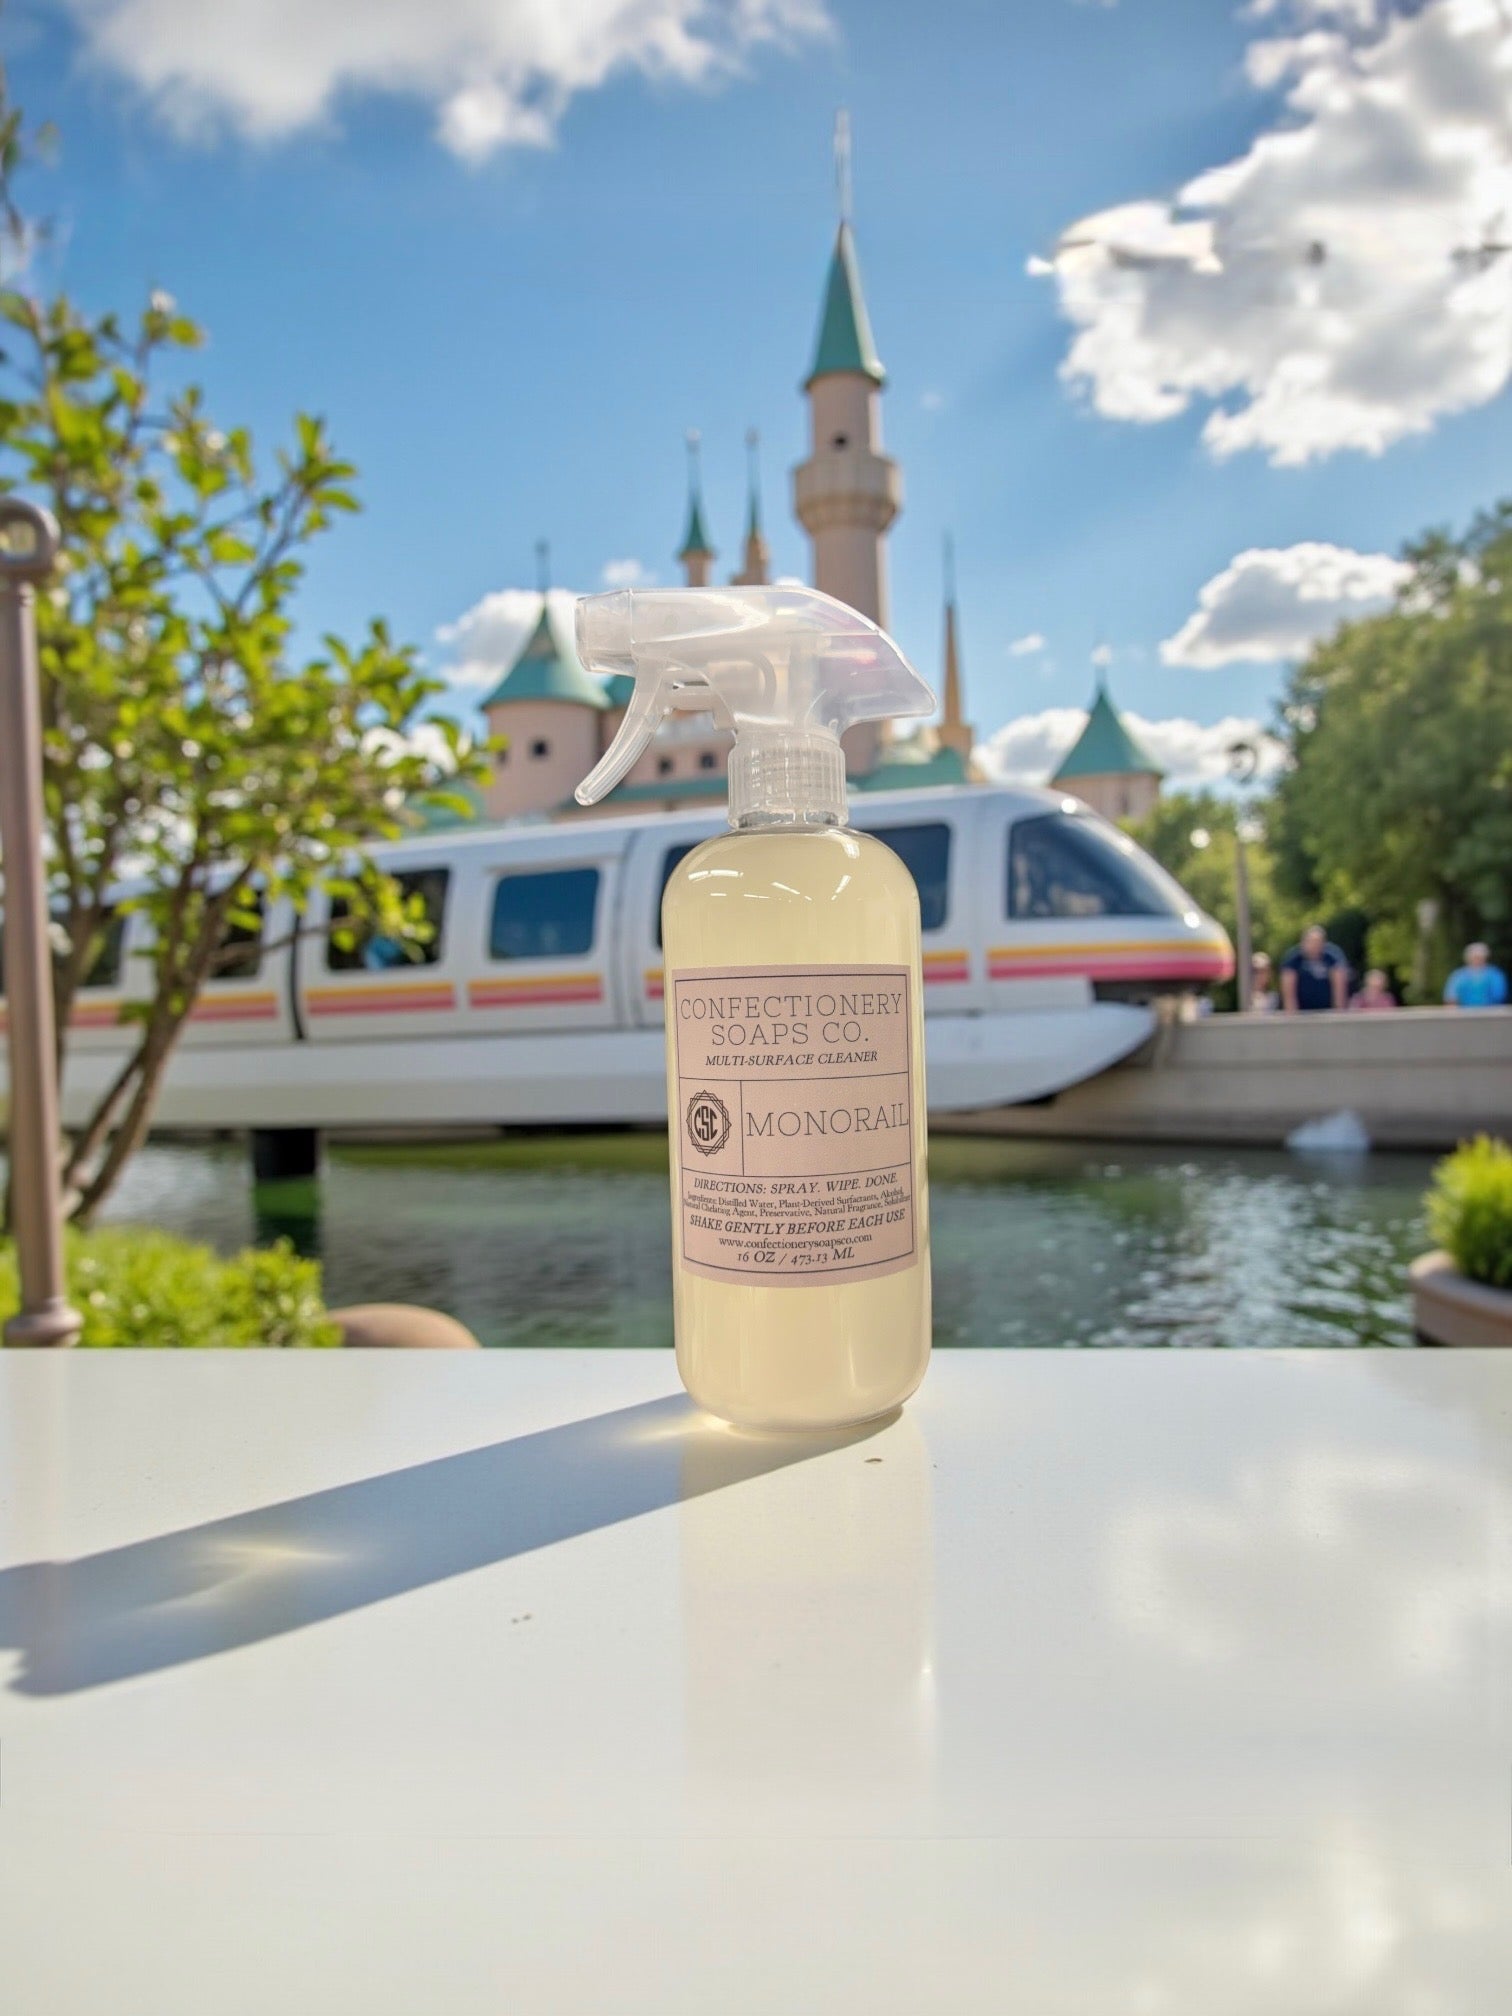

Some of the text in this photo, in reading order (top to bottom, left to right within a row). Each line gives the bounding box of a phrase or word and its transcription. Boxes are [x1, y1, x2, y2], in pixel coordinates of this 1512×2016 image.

[680, 993, 902, 1019] CONFECTIONERY
[711, 1021, 869, 1046] SOAPS CO.
[705, 1051, 878, 1066] MULTI-SURFACE CLEANER
[694, 1105, 718, 1141] CSC
[746, 1102, 909, 1136] MONORAIL
[694, 1177, 766, 1194] DIRECTIONS:
[770, 1182, 820, 1194] SPRAY.
[826, 1178, 861, 1192] WIPE.
[701, 1203, 731, 1216] Chelating
[732, 1207, 758, 1217] Agent,
[760, 1208, 812, 1217] Preservative,
[815, 1205, 846, 1216] Natural
[718, 1197, 747, 1208] Distilled
[749, 1199, 777, 1209] Water,
[779, 1198, 835, 1208] Plant-Derived
[837, 1195, 879, 1205] Surfactants,
[690, 1208, 906, 1235] SHAKE GENTLY BEFORE EACH USE
[719, 1234, 872, 1251] www.confectionerysoapsco.com
[737, 1246, 855, 1266] 16 OZ / 473.13 ML
